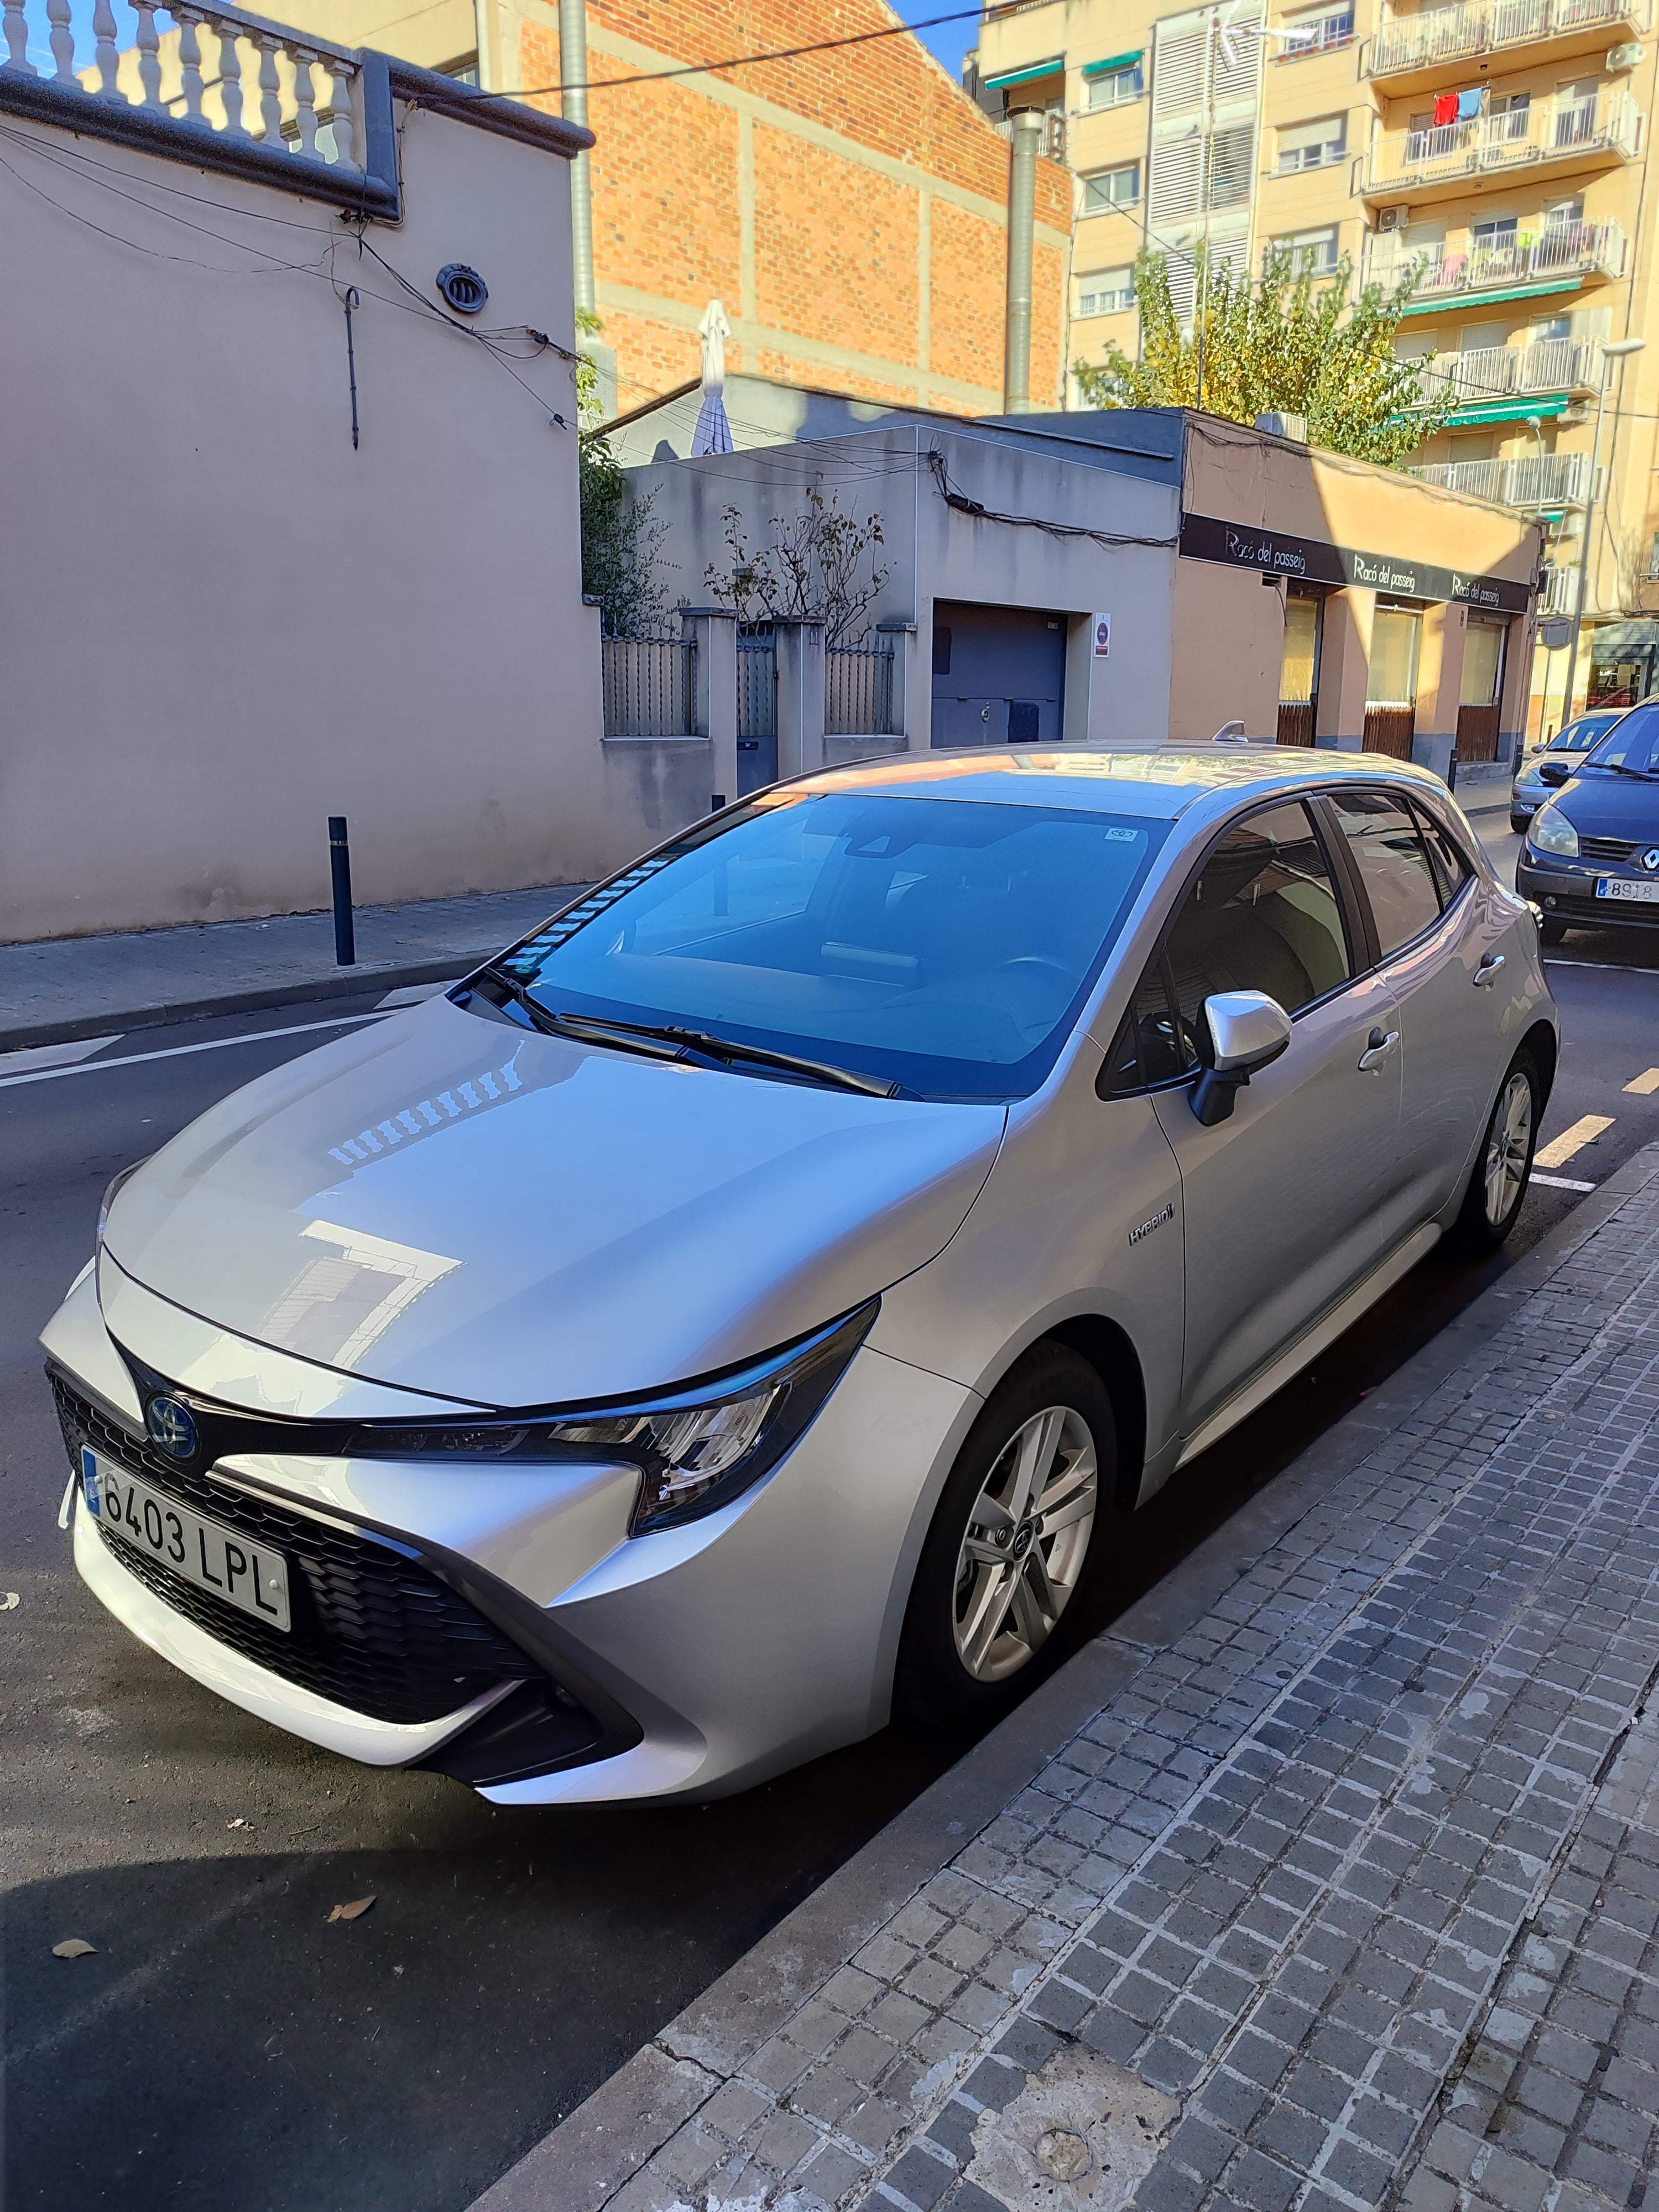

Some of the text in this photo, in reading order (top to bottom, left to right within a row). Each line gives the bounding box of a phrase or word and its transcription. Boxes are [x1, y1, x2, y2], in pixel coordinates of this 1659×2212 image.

[1258, 541, 1272, 563] del
[1274, 549, 1306, 575] passeig
[1353, 553, 1415, 593] Racó del passeig
[1452, 573, 1499, 607] Racó del passeig
[105, 1472, 278, 1616] 6403 LPL
